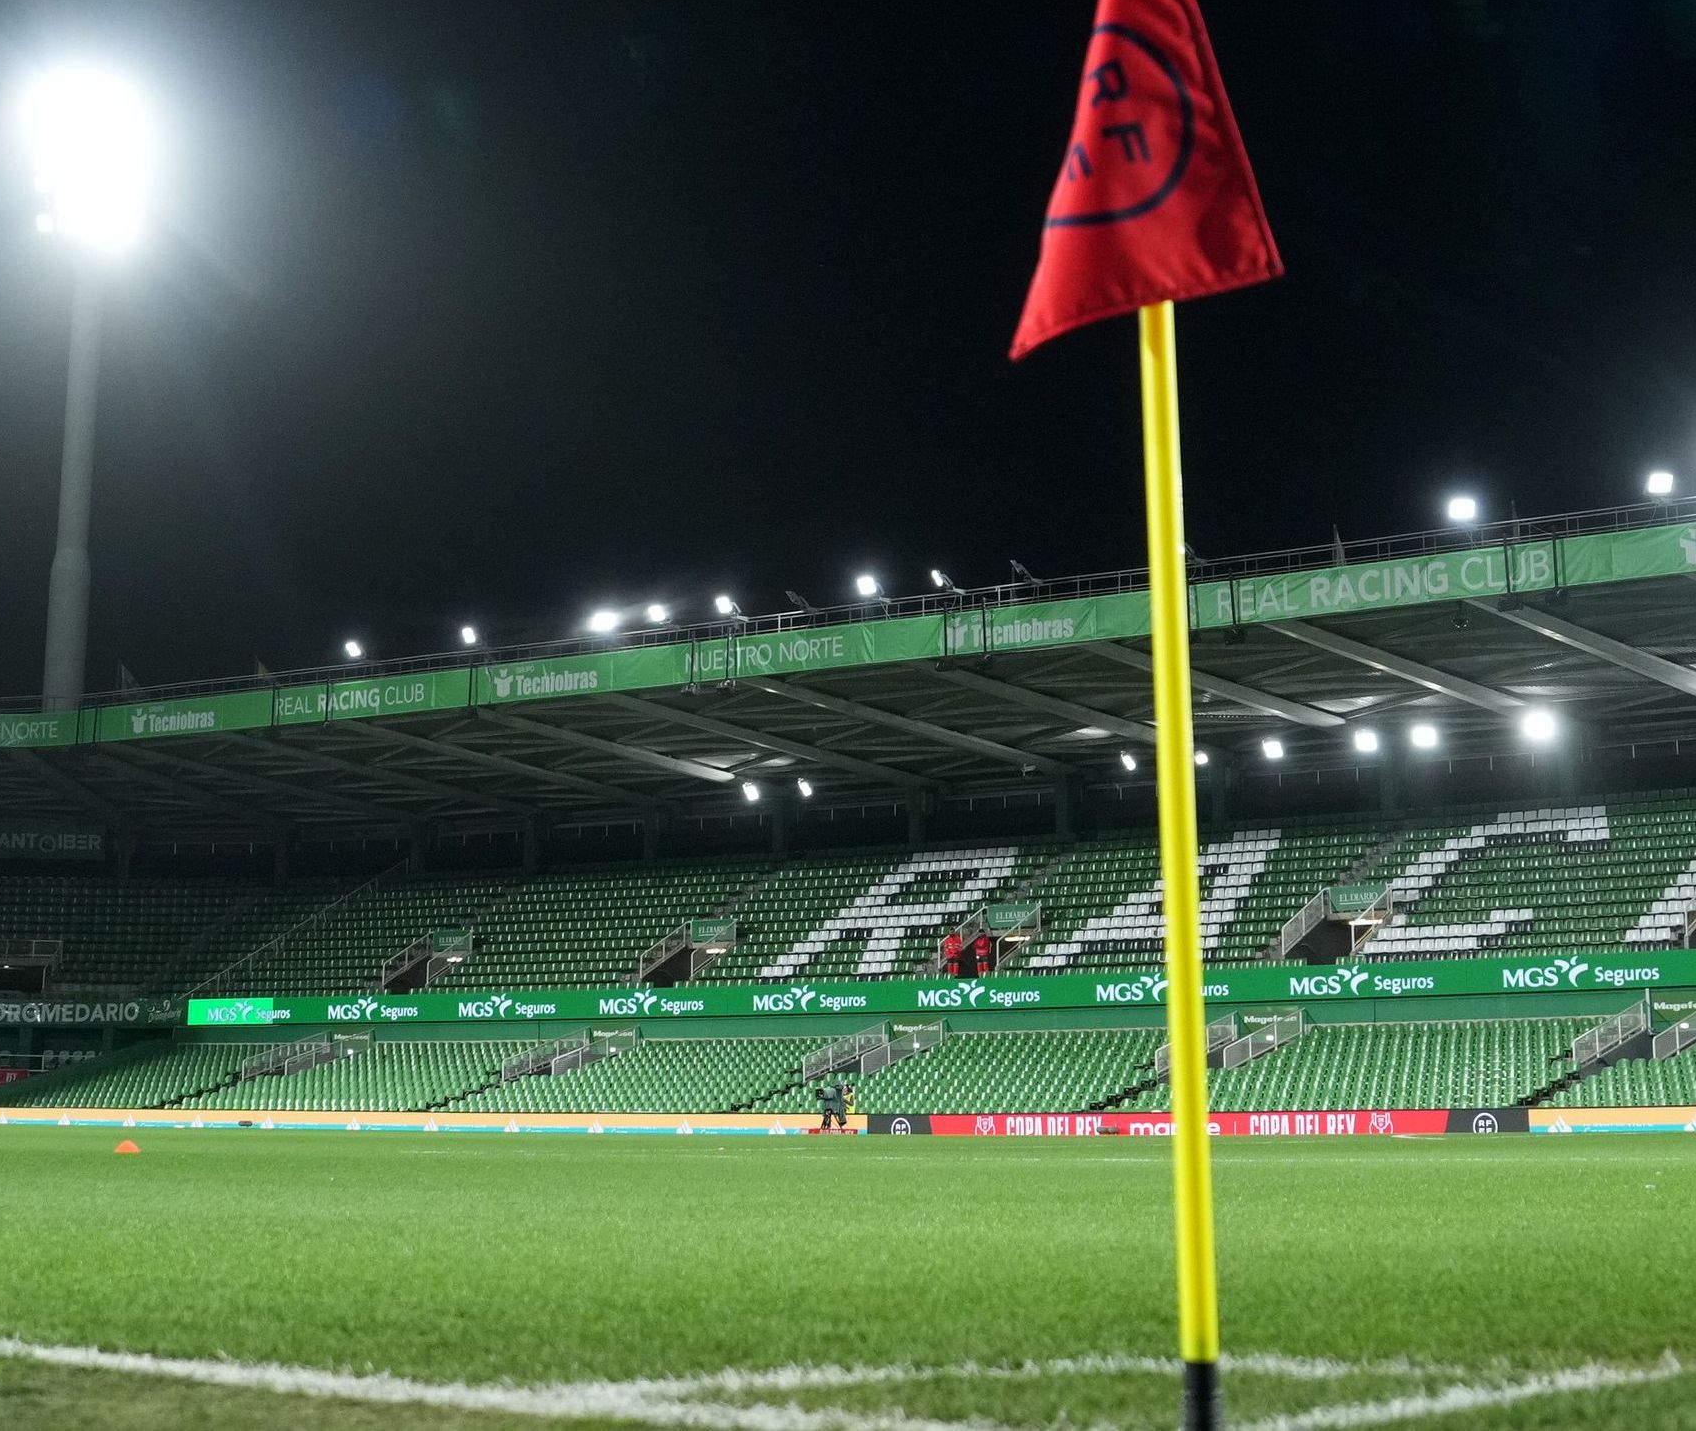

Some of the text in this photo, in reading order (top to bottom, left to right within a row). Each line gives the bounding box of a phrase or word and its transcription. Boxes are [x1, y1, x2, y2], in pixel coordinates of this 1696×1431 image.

[1217, 549, 1551, 620] REAL RACING CLUB
[970, 616, 1074, 647] Tecniobras
[684, 636, 843, 673] NUESTRO NORTE
[515, 668, 598, 695] Tecniobras
[275, 682, 424, 717] REAL RACING CLUB
[1, 718, 59, 741] NORTE
[149, 710, 215, 734] Tecniobras
[1351, 892, 1379, 902] DIARIO
[1289, 972, 1434, 996] MGS Seguros
[1503, 963, 1660, 988] MGS Seguros
[753, 993, 867, 1012] MGS Seguros
[917, 987, 1040, 1008] MGS Seguros
[1096, 983, 1141, 1002] MGS
[207, 1006, 291, 1022] MGS Seguros
[327, 1004, 418, 1021] MGS Seguros
[458, 1001, 556, 1018] MGS Seguros
[599, 997, 704, 1016] MGS Seguros
[1006, 1117, 1044, 1135] COPA
[1076, 1117, 1102, 1135] REY
[1130, 1122, 1221, 1135] mae
[1250, 1116, 1290, 1135] COPA
[1326, 1114, 1356, 1134] REY
[1477, 1119, 1494, 1127] RF
